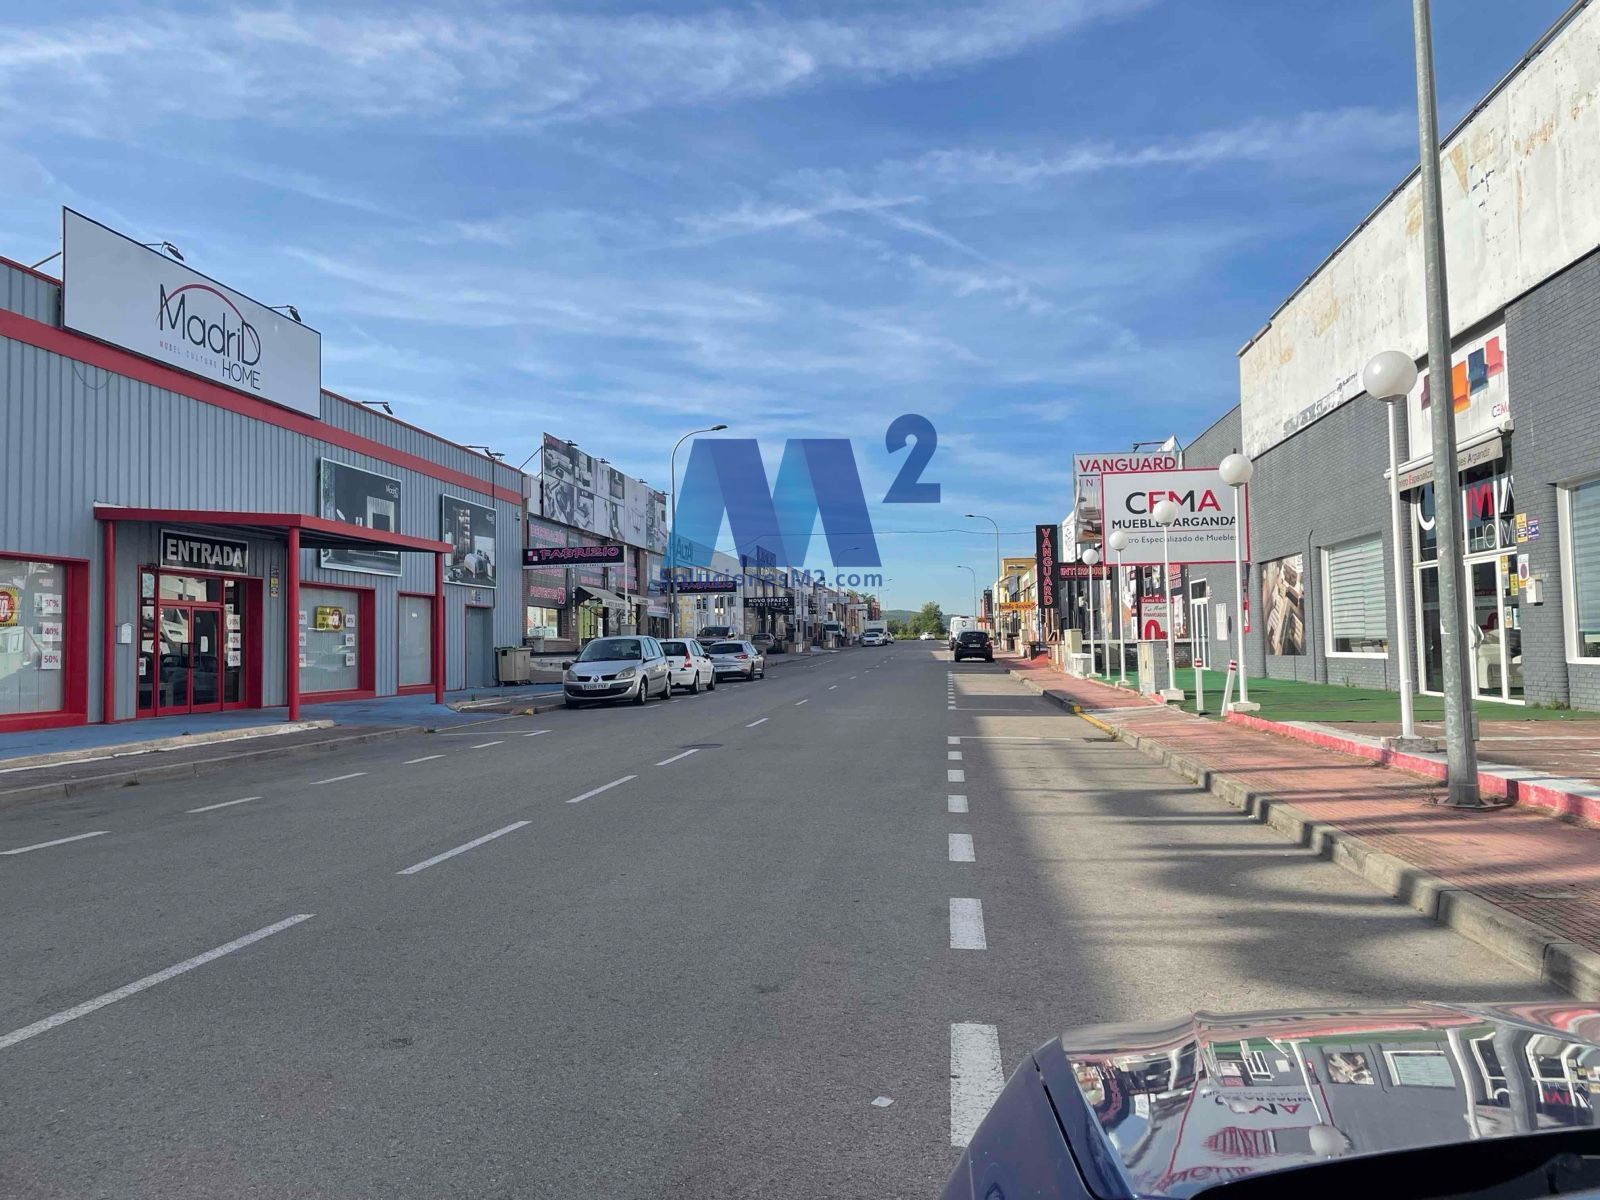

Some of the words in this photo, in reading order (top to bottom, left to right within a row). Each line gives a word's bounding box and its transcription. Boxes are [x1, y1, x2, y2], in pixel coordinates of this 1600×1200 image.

[222, 358, 261, 391] HOME
[1079, 456, 1176, 472] VANGUARD
[1112, 519, 1170, 529] MUEBLE
[167, 539, 243, 567] ENTRADA
[540, 547, 619, 560] FABRIZIO
[1041, 528, 1053, 606] VANGUARD
[45, 627, 59, 635] 40%
[44, 655, 58, 663] 50%
